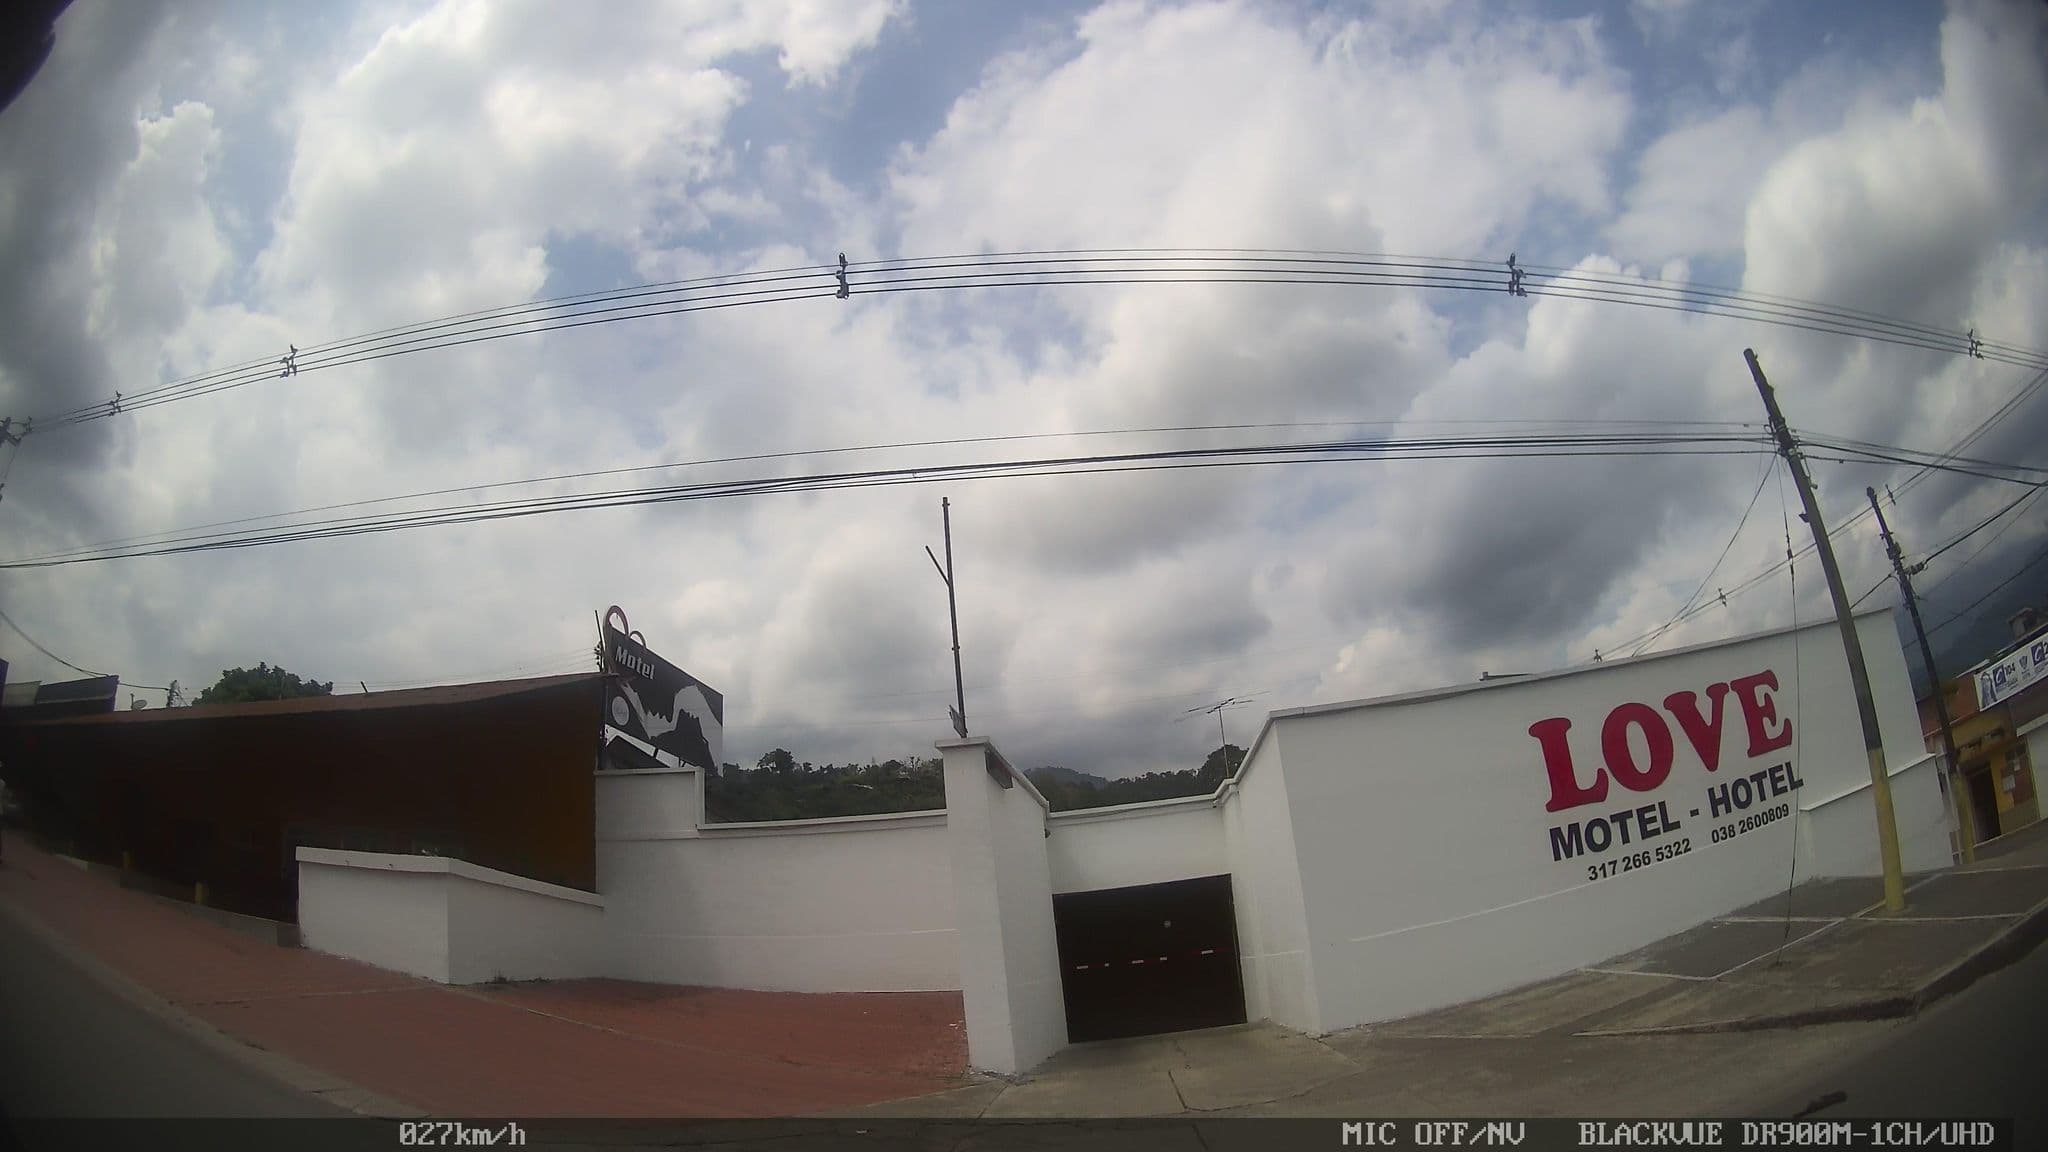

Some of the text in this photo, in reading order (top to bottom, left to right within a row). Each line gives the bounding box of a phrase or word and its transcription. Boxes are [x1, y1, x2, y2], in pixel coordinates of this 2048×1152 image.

[615, 646, 655, 681] Motel
[1528, 669, 1793, 813] LOVE
[1549, 800, 1682, 862] MOTEL
[1707, 761, 1804, 819] HOTEL
[1711, 803, 1790, 844] 038 2600809
[1587, 838, 1692, 882] 317 266 5322
